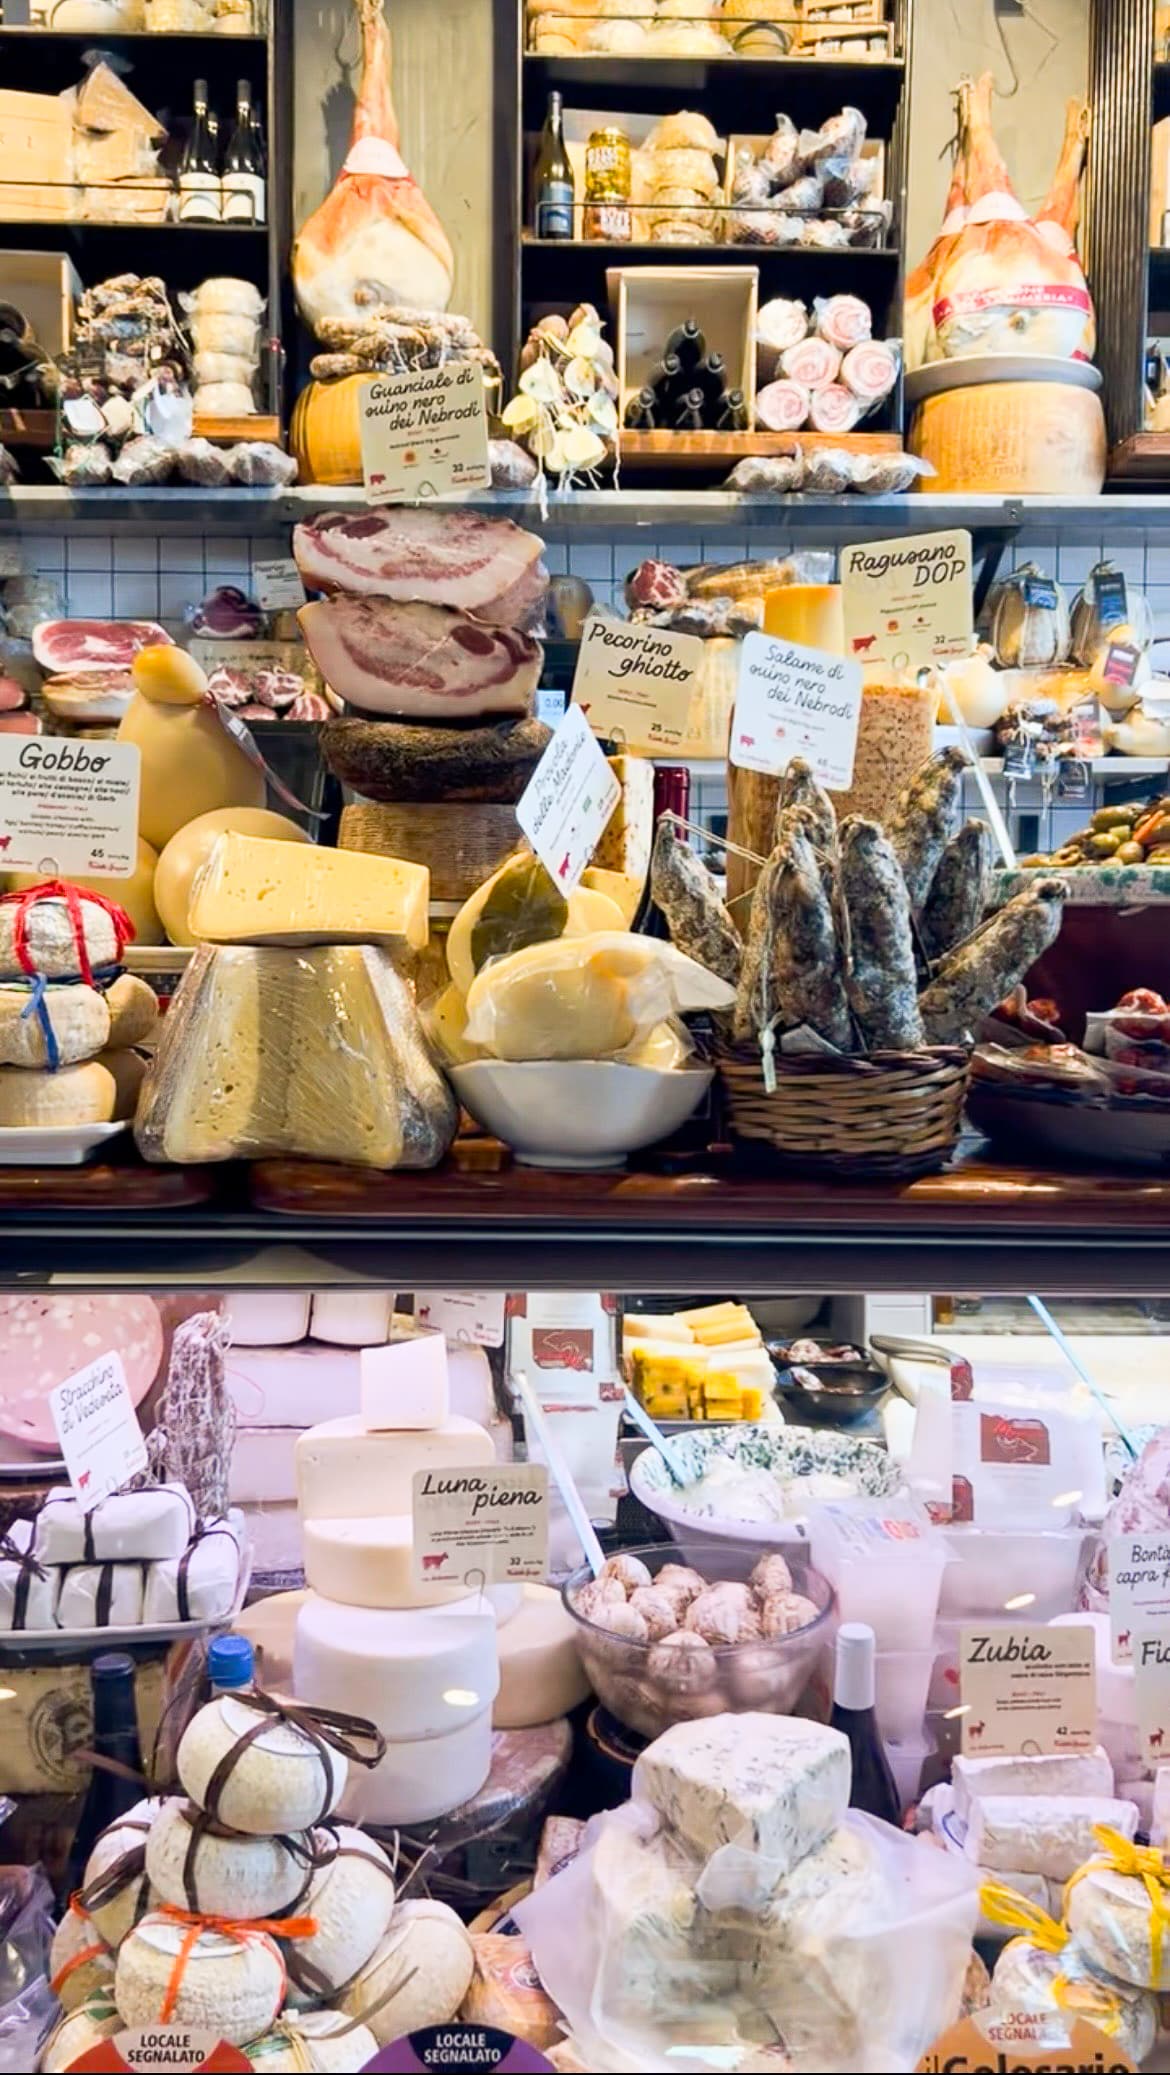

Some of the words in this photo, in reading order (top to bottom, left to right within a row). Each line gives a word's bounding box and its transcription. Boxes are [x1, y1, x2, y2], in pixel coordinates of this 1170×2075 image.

[370, 372, 454, 400] Guanciale
[456, 368, 474, 384] di
[412, 394, 446, 410] nero
[390, 413, 414, 431] dei
[418, 400, 481, 426] Nebrodi
[849, 544, 956, 578] Ragusano
[913, 560, 966, 587] DOP
[588, 623, 673, 656] Pecorino
[608, 655, 694, 681] ghiotto
[765, 644, 825, 675] Salame
[827, 663, 844, 680] di
[794, 676, 826, 694] nero
[767, 685, 792, 704] dei
[794, 690, 853, 720] Nebrodi
[19, 742, 111, 773] Gobbo
[532, 796, 554, 836] delle
[91, 848, 105, 858] 45
[421, 1474, 487, 1496] Luna
[472, 1485, 543, 1517] piena
[510, 1556, 521, 1566] 32
[1116, 1570, 1160, 1591] capra
[967, 1636, 1052, 1663] Zubia
[1056, 1726, 1068, 1735] 42
[1001, 2012, 1046, 2025] OCALE
[140, 2034, 191, 2048] LOCALE
[436, 2032, 486, 2048] LOCALE
[988, 2027, 1060, 2041] SEGNALA
[128, 2049, 205, 2063] SEGNALATO
[424, 2048, 502, 2064] SEGNALATO
